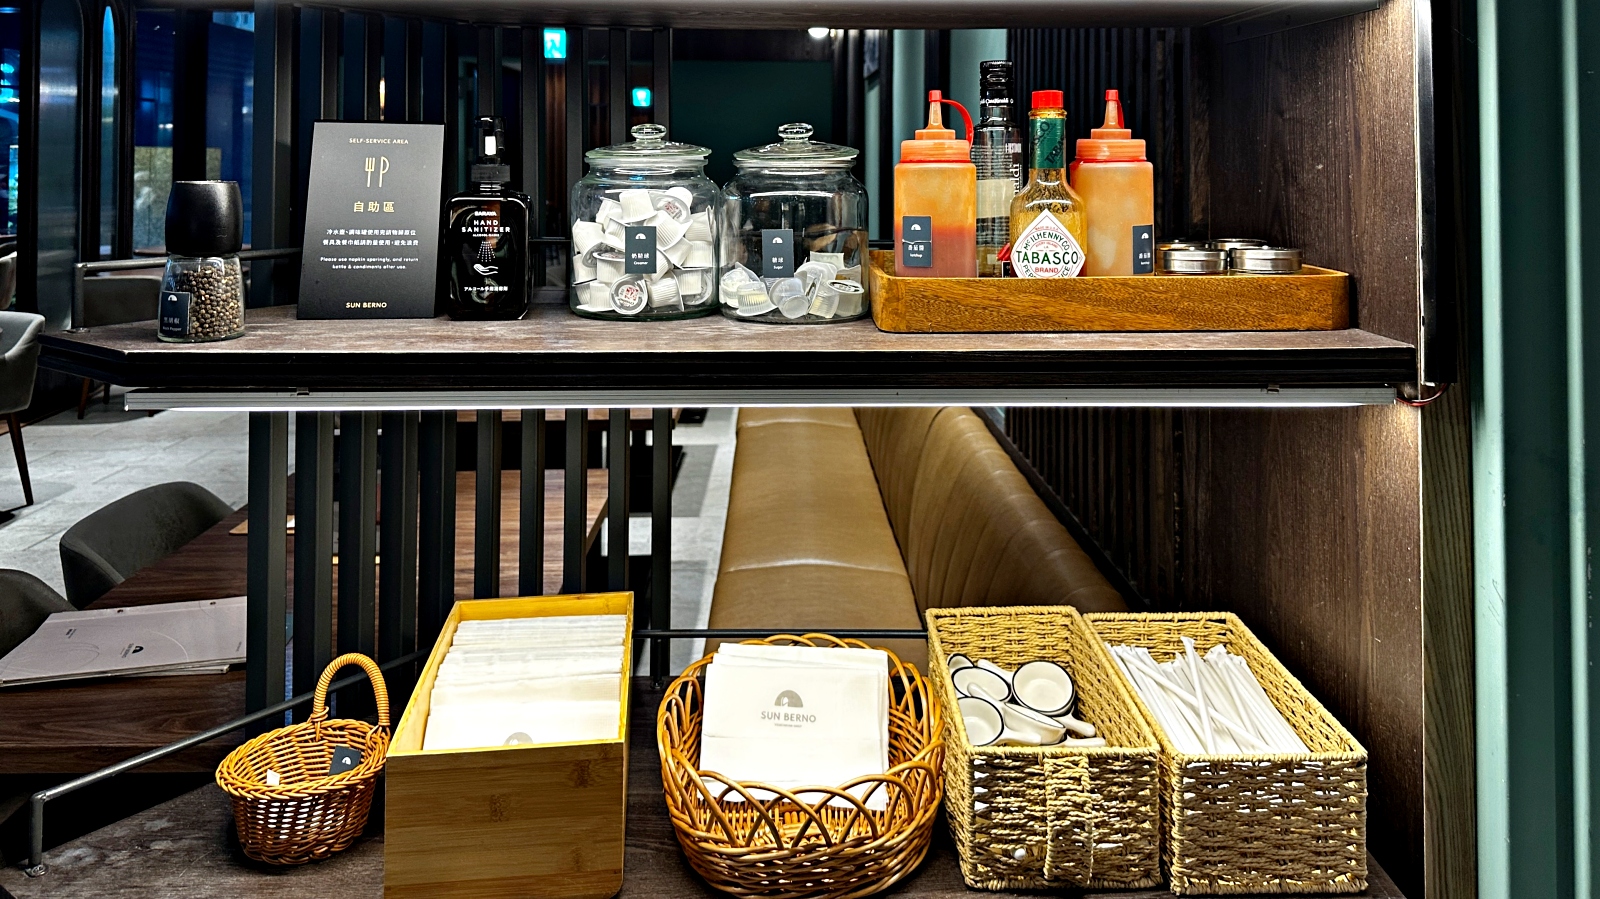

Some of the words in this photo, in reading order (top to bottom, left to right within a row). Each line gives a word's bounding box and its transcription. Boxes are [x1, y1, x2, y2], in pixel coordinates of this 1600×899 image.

[353, 201, 394, 212] 自助區
[1016, 250, 1078, 265] TABASCO
[761, 710, 780, 720] SUN
[784, 712, 817, 723] BERNO
